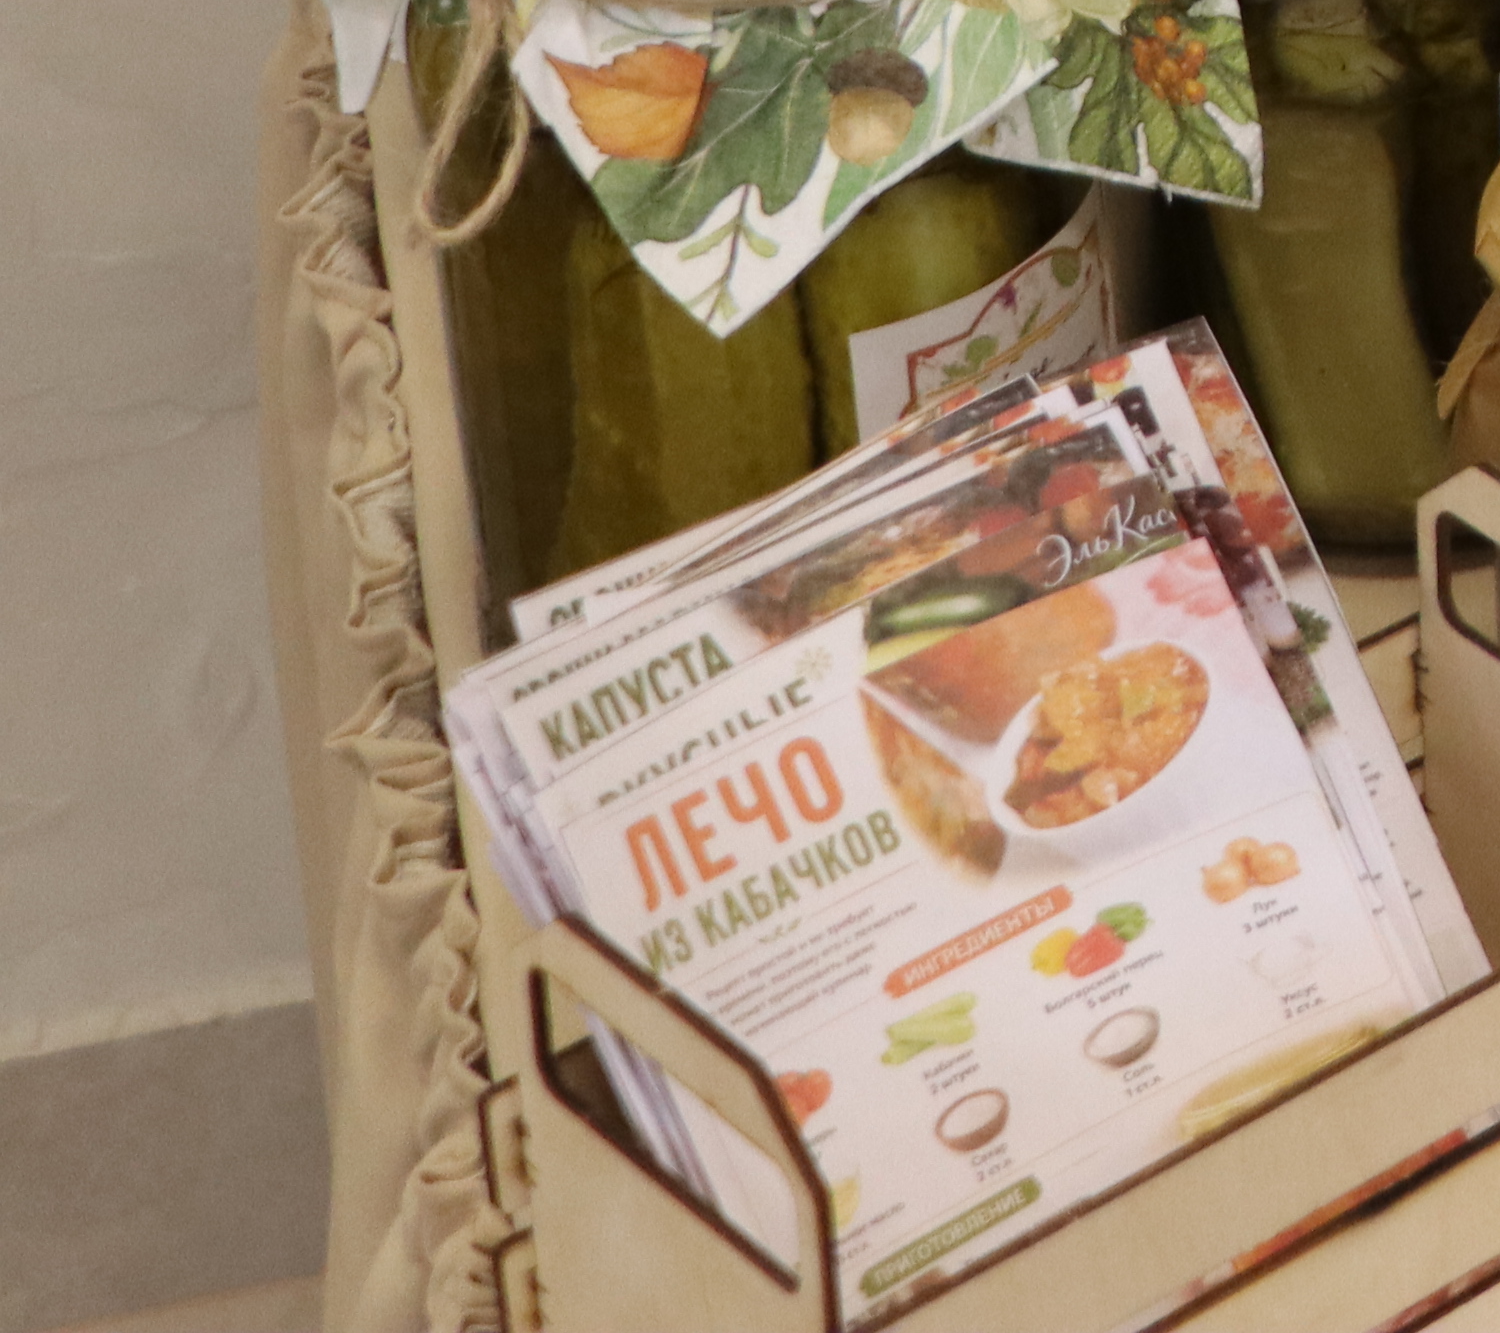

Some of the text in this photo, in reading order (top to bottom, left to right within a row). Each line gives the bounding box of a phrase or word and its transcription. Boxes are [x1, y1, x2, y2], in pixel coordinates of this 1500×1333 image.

[539, 632, 734, 761] КАПУСТА
[626, 735, 845, 913] ЛЕЧО
[641, 809, 901, 975] ИЗ КАБАЧКОВ
[902, 895, 1056, 988] ИНГРЕДИЕНТЫ
[872, 1186, 1026, 1286] ПРИГОТОВЛЕНИЕ
